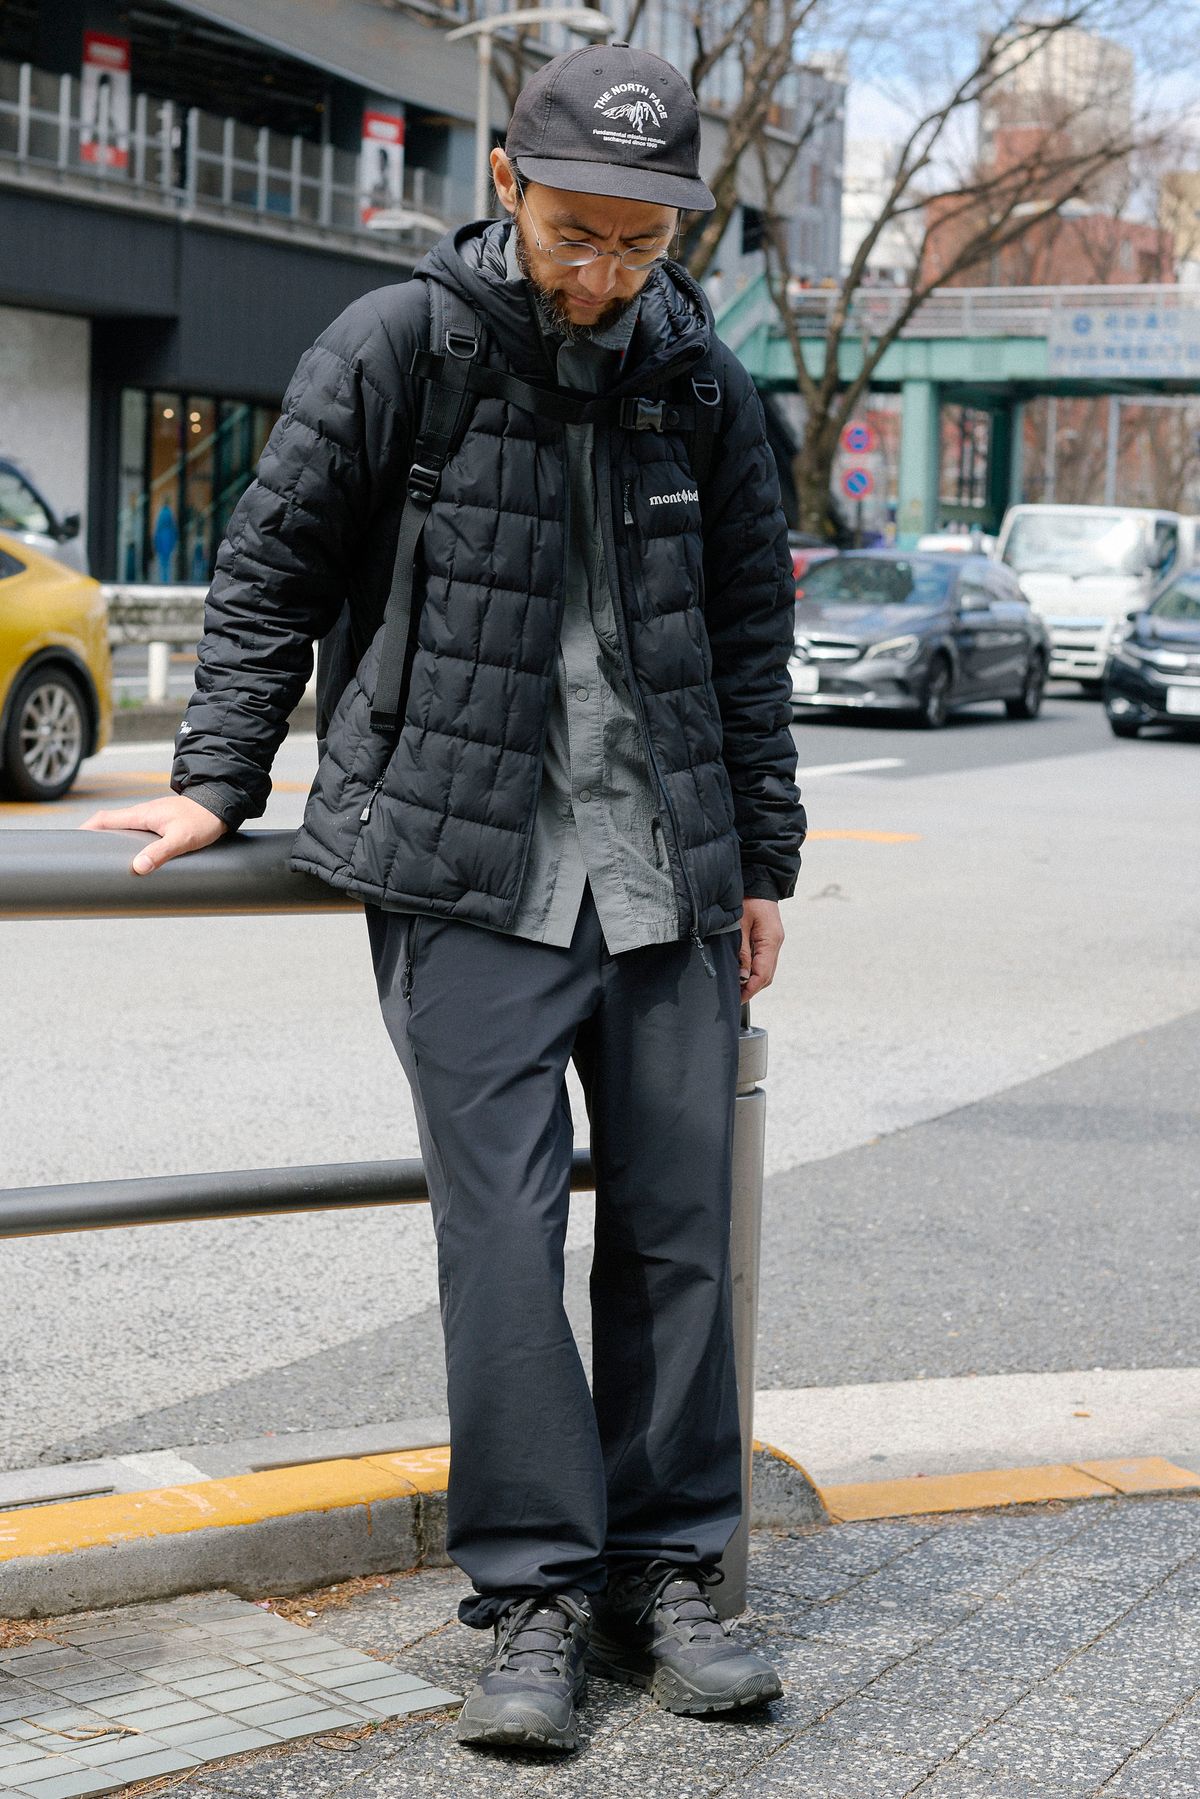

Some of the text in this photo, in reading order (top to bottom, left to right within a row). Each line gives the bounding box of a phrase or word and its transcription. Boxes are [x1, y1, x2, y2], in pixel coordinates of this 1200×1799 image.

[593, 83, 668, 119] THE NORTH FACE
